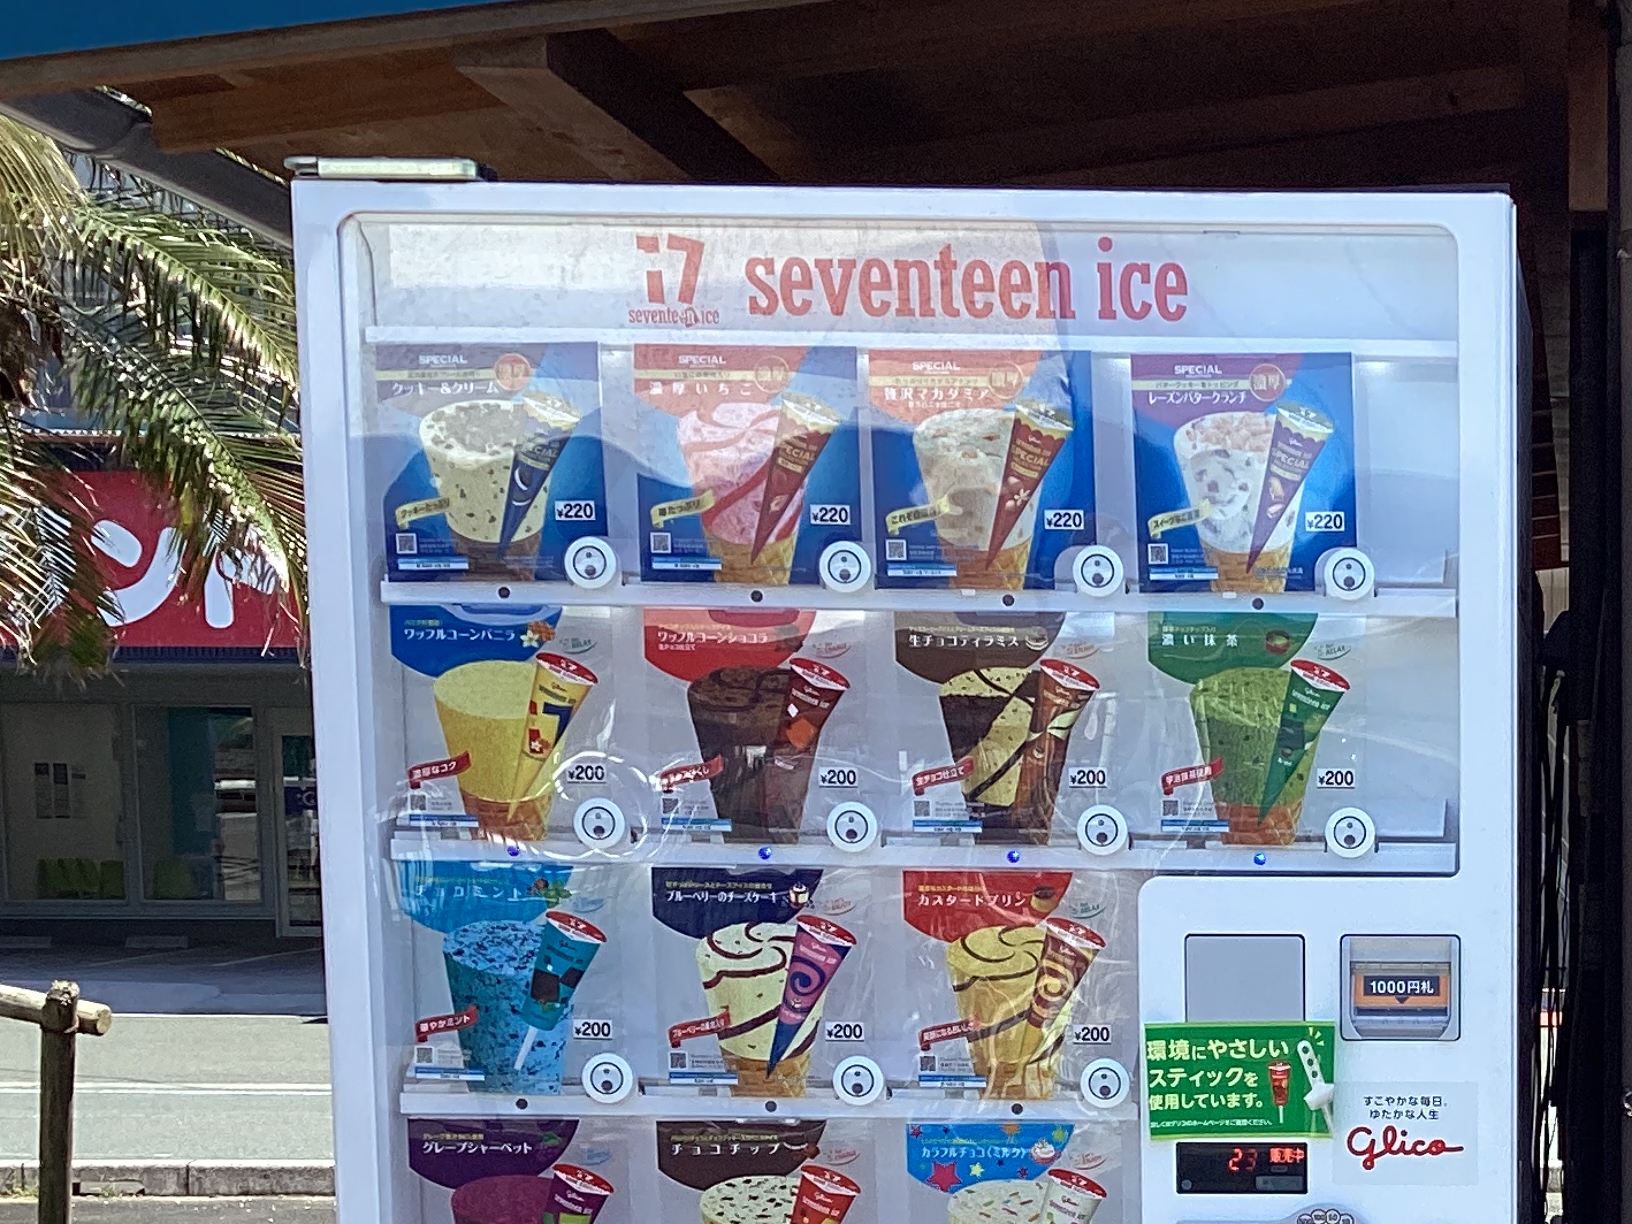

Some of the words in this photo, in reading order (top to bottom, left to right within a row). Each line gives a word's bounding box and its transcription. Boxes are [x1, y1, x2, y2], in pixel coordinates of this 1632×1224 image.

[744, 242, 1076, 320] seventeen
[1097, 236, 1188, 322] ice
[419, 354, 468, 365] SPECIAL
[678, 355, 727, 365] SPECIAL
[912, 361, 961, 372] SPECIAL
[1174, 365, 1223, 375] SPECIAL
[884, 387, 990, 402] 贅沢マカダミア
[1149, 390, 1247, 406] レーズンバタークランチ
[557, 501, 595, 520] ¥220
[812, 506, 850, 524] ¥220
[1046, 511, 1083, 529] ¥220
[1307, 513, 1344, 530] ¥220
[403, 627, 517, 642] ワッフルコーンバニラ
[908, 634, 1020, 649] 生チョコティラミス
[1161, 633, 1239, 648] 濃い抹茶
[567, 764, 607, 782] ¥200
[820, 768, 858, 786] ¥200
[1069, 768, 1107, 786] ¥200
[1317, 769, 1355, 787] ¥200
[917, 893, 1027, 908] カスタードプリン
[1369, 979, 1434, 995] 1000円札
[574, 1021, 612, 1037] ¥200
[826, 1023, 864, 1040] ¥200
[1074, 1026, 1111, 1043] ¥200
[1146, 1038, 1290, 1061] 環境にやさしい
[1149, 1066, 1259, 1088] スティックを
[1149, 1093, 1264, 1111] 使用しています。
[1369, 1108, 1440, 1121] ゆたかな人生
[422, 1140, 534, 1155] グレープシャーベット
[671, 1143, 782, 1156] チョコチップ
[1346, 1124, 1466, 1171] Glico
